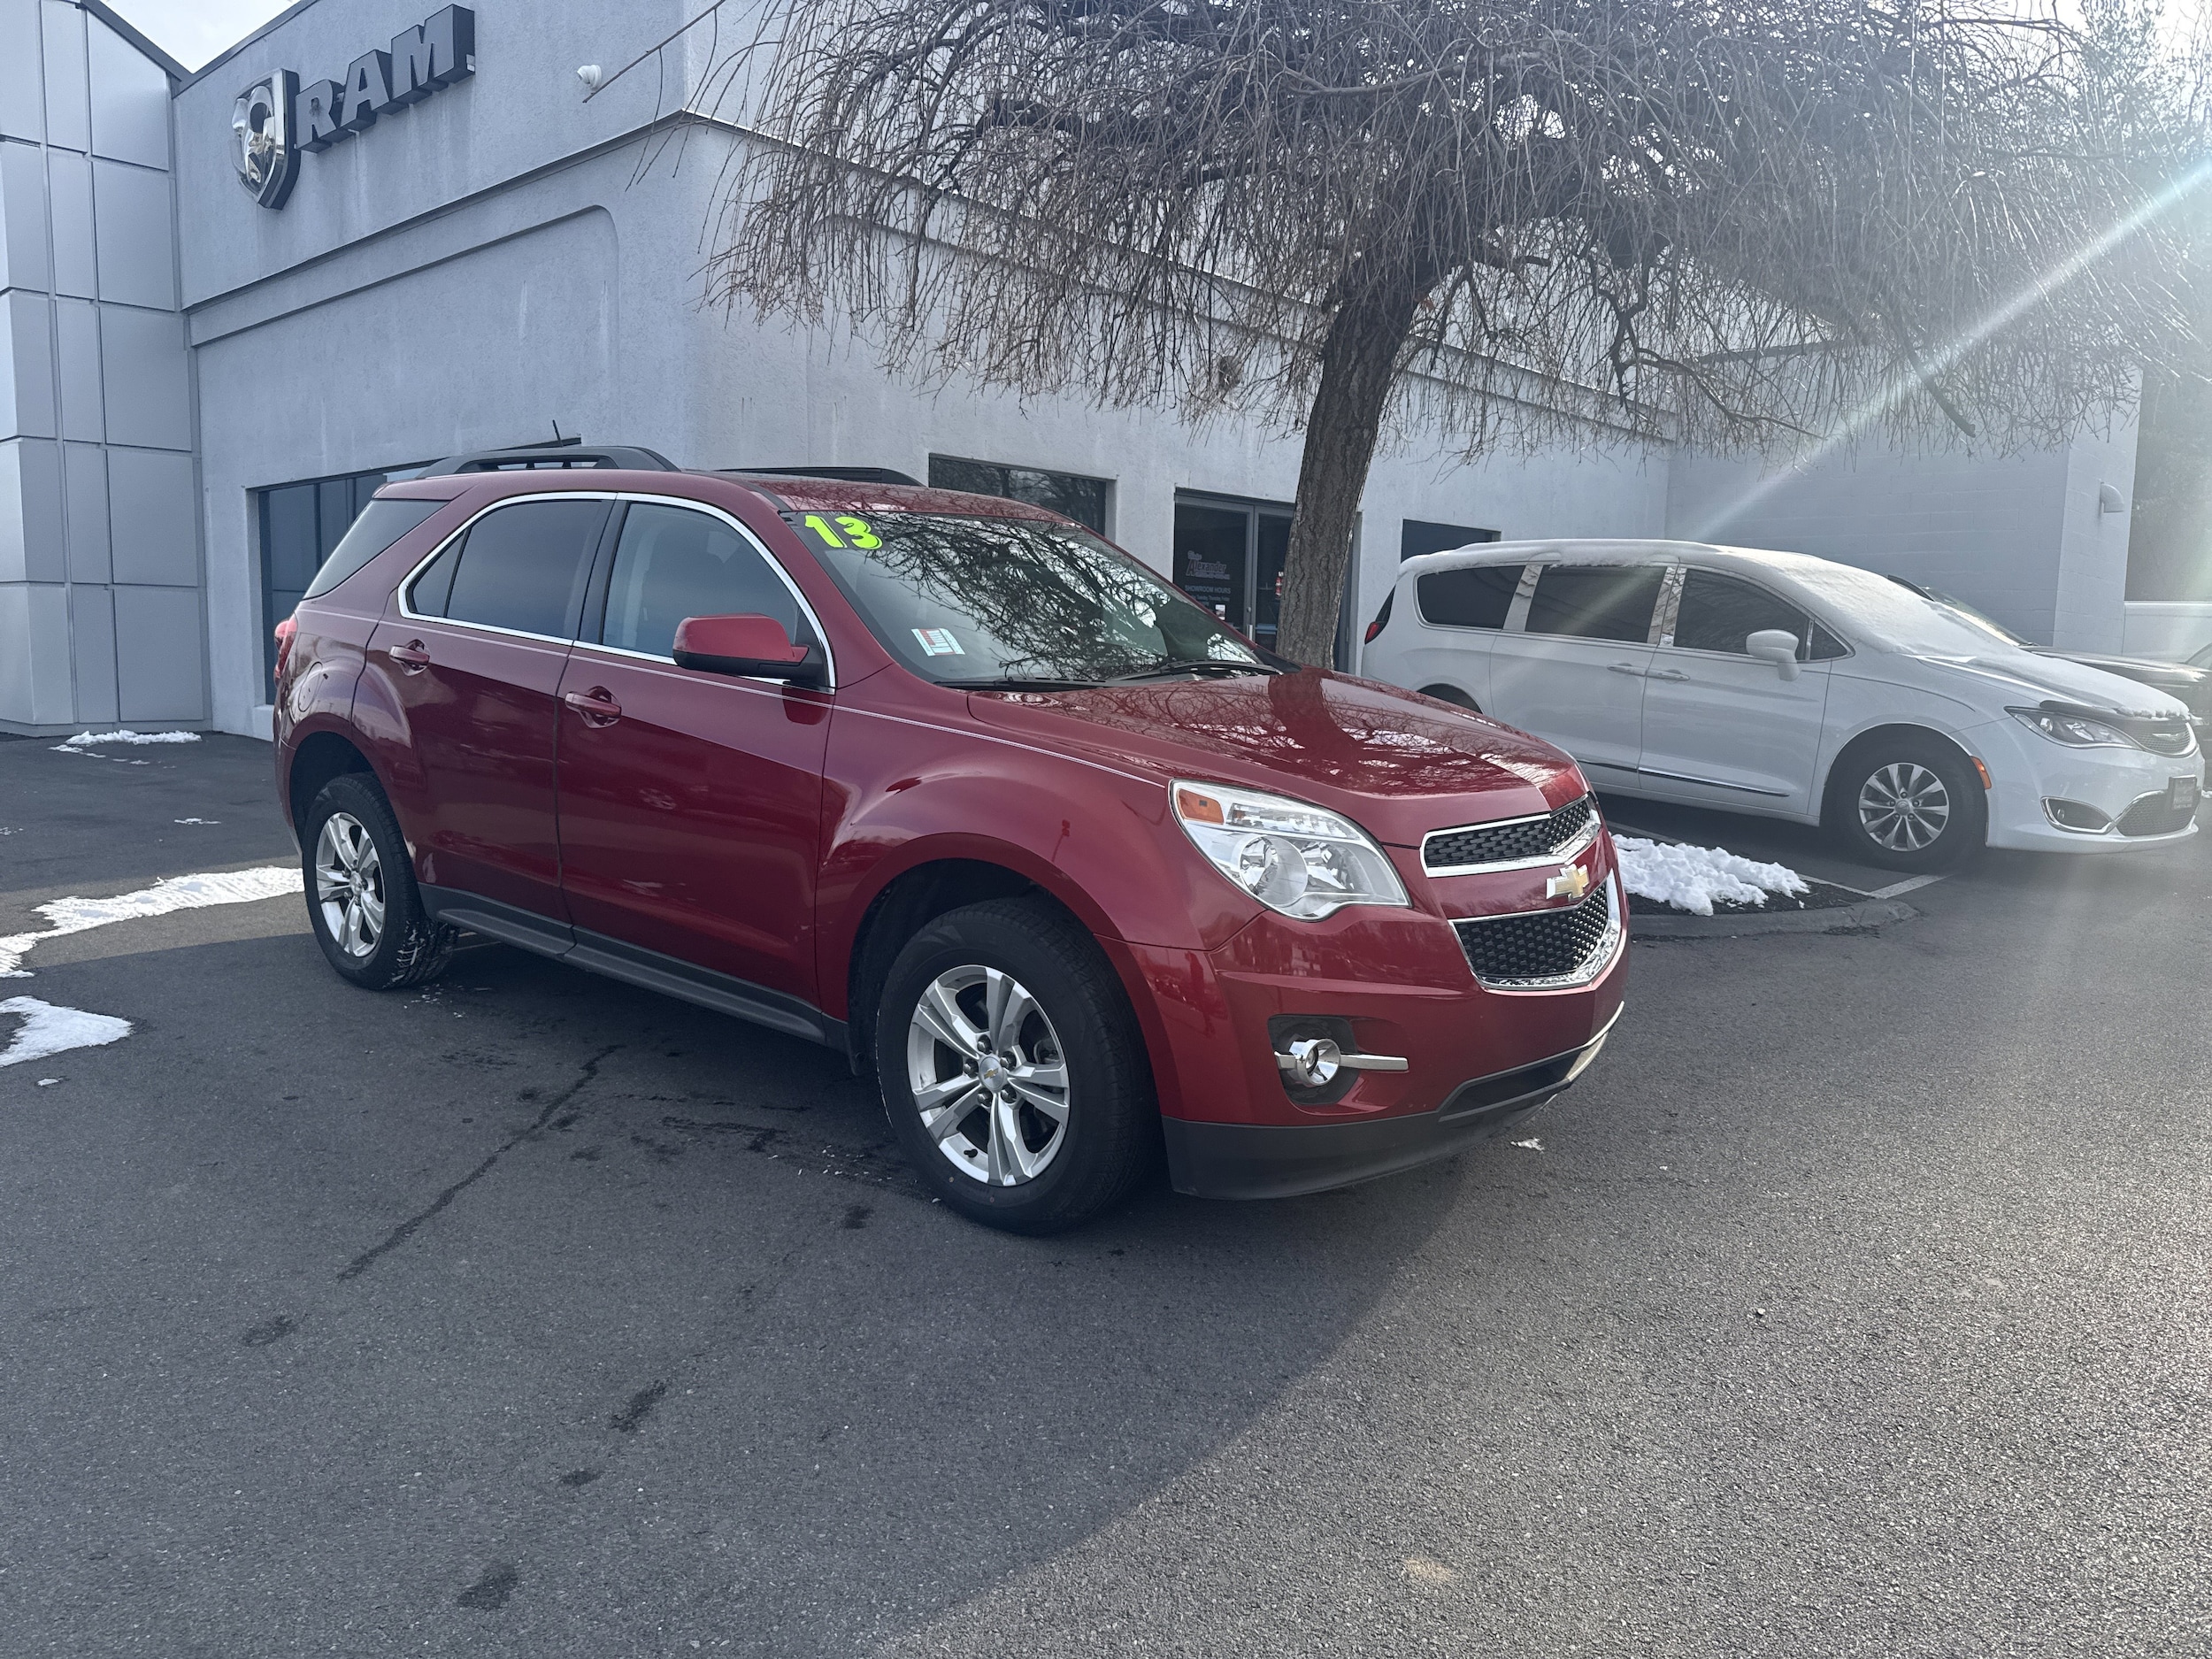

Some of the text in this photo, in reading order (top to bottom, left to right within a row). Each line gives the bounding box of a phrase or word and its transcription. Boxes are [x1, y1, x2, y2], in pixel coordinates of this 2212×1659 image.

[296, 4, 457, 150] RAM
[805, 515, 883, 549] 13
[1187, 558, 1227, 576] Alexander
